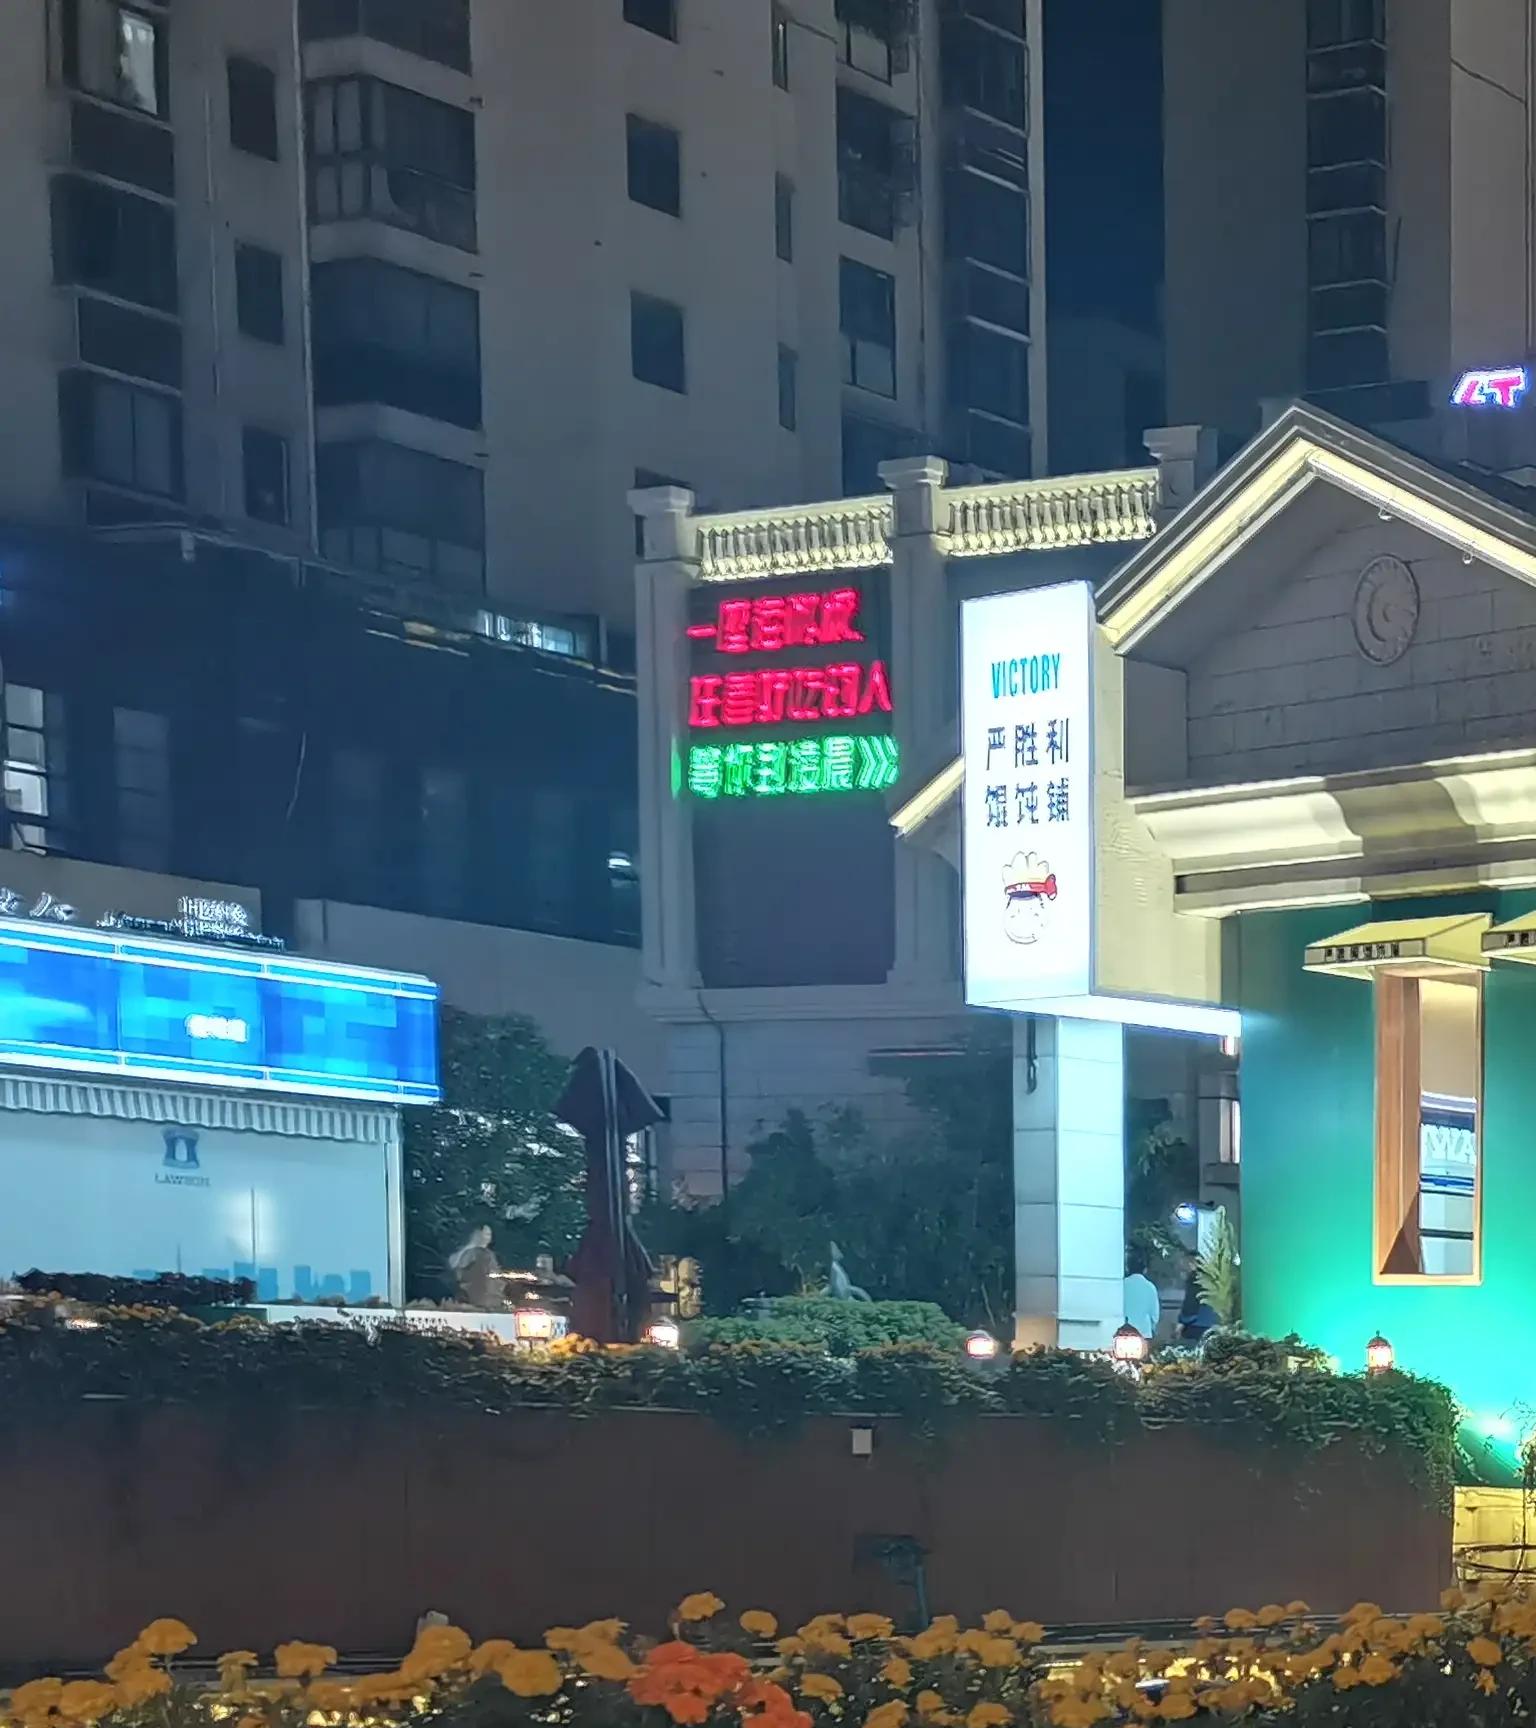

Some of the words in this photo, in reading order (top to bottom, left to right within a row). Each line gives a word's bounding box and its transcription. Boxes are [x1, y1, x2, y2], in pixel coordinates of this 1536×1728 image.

[991, 652, 1061, 699] VICTORY
[985, 716, 1070, 771] 严胜利
[985, 778, 1070, 828] 馄饨铺
